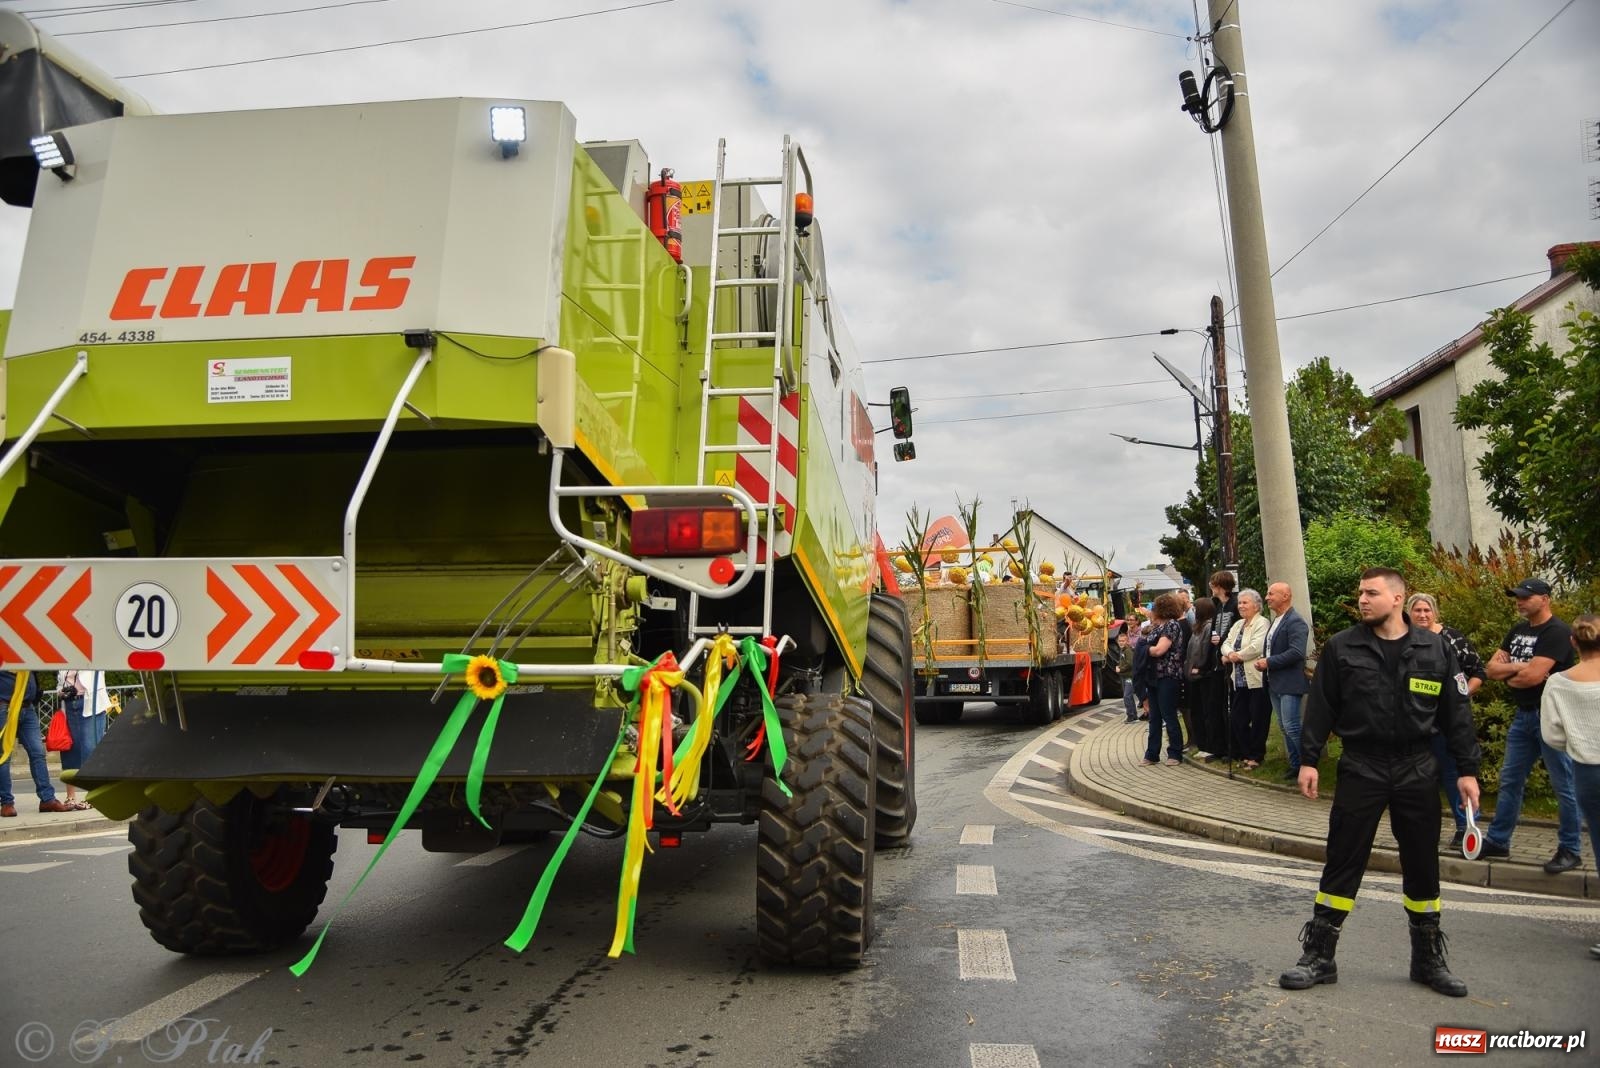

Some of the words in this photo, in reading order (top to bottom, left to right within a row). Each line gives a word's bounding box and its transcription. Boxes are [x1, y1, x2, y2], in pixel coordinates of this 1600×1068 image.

[108, 255, 417, 321] CLAAS
[79, 331, 112, 344] 454-
[118, 330, 156, 343] 4338
[127, 594, 165, 638] 20
